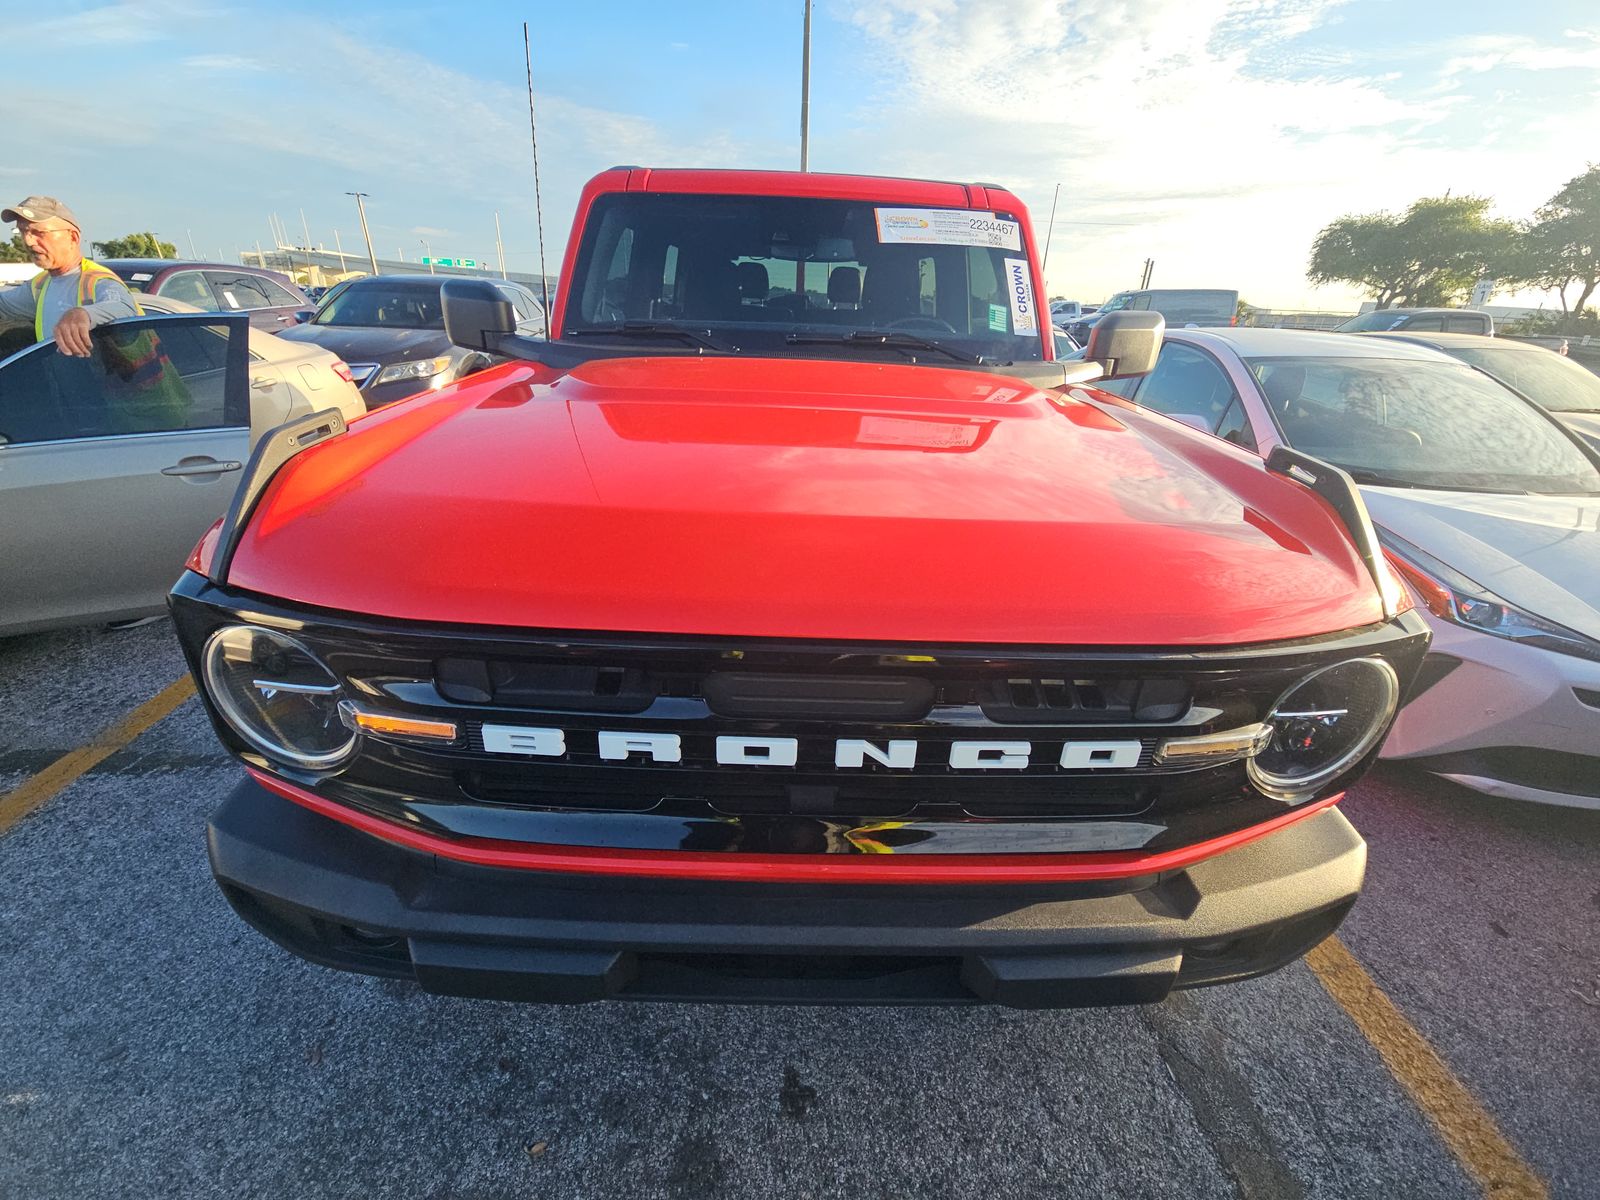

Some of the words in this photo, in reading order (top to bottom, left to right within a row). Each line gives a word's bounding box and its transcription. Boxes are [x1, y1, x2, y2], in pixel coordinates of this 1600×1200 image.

[969, 218, 1014, 235] 2234467
[1012, 265, 1028, 313] CROWN
[481, 724, 1143, 769] BRONCO
